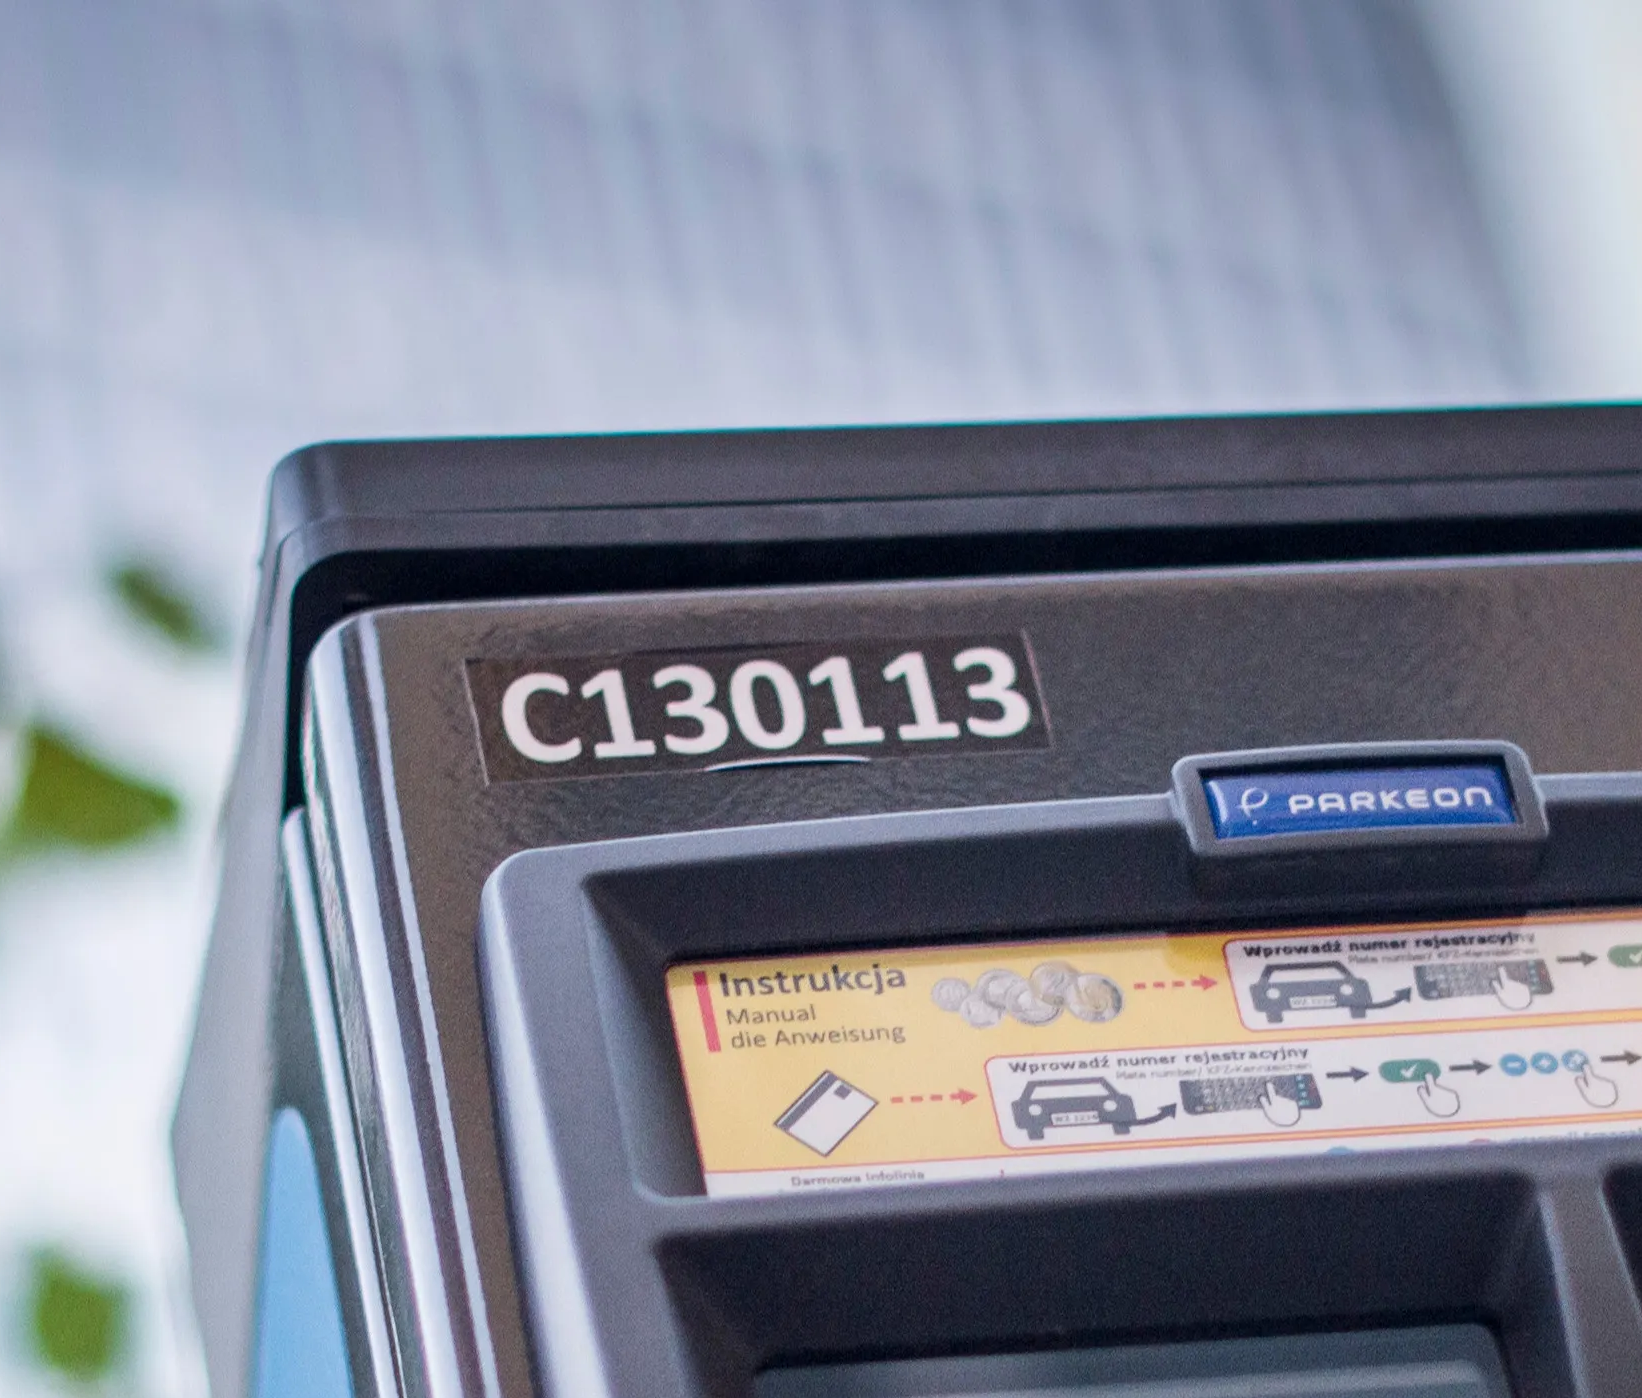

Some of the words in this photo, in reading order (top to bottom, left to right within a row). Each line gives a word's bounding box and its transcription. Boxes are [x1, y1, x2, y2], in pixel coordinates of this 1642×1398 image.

[500, 646, 1033, 763] C130113
[1288, 786, 1493, 815] PARKEON
[1349, 939, 1407, 952] numer
[719, 963, 906, 997] Instrukcja
[726, 1004, 817, 1025] Manual
[731, 1030, 766, 1049] die
[775, 1025, 906, 1046] Anweisung
[1117, 1053, 1176, 1067] numer
[1185, 1047, 1309, 1064] rejestracyjny
